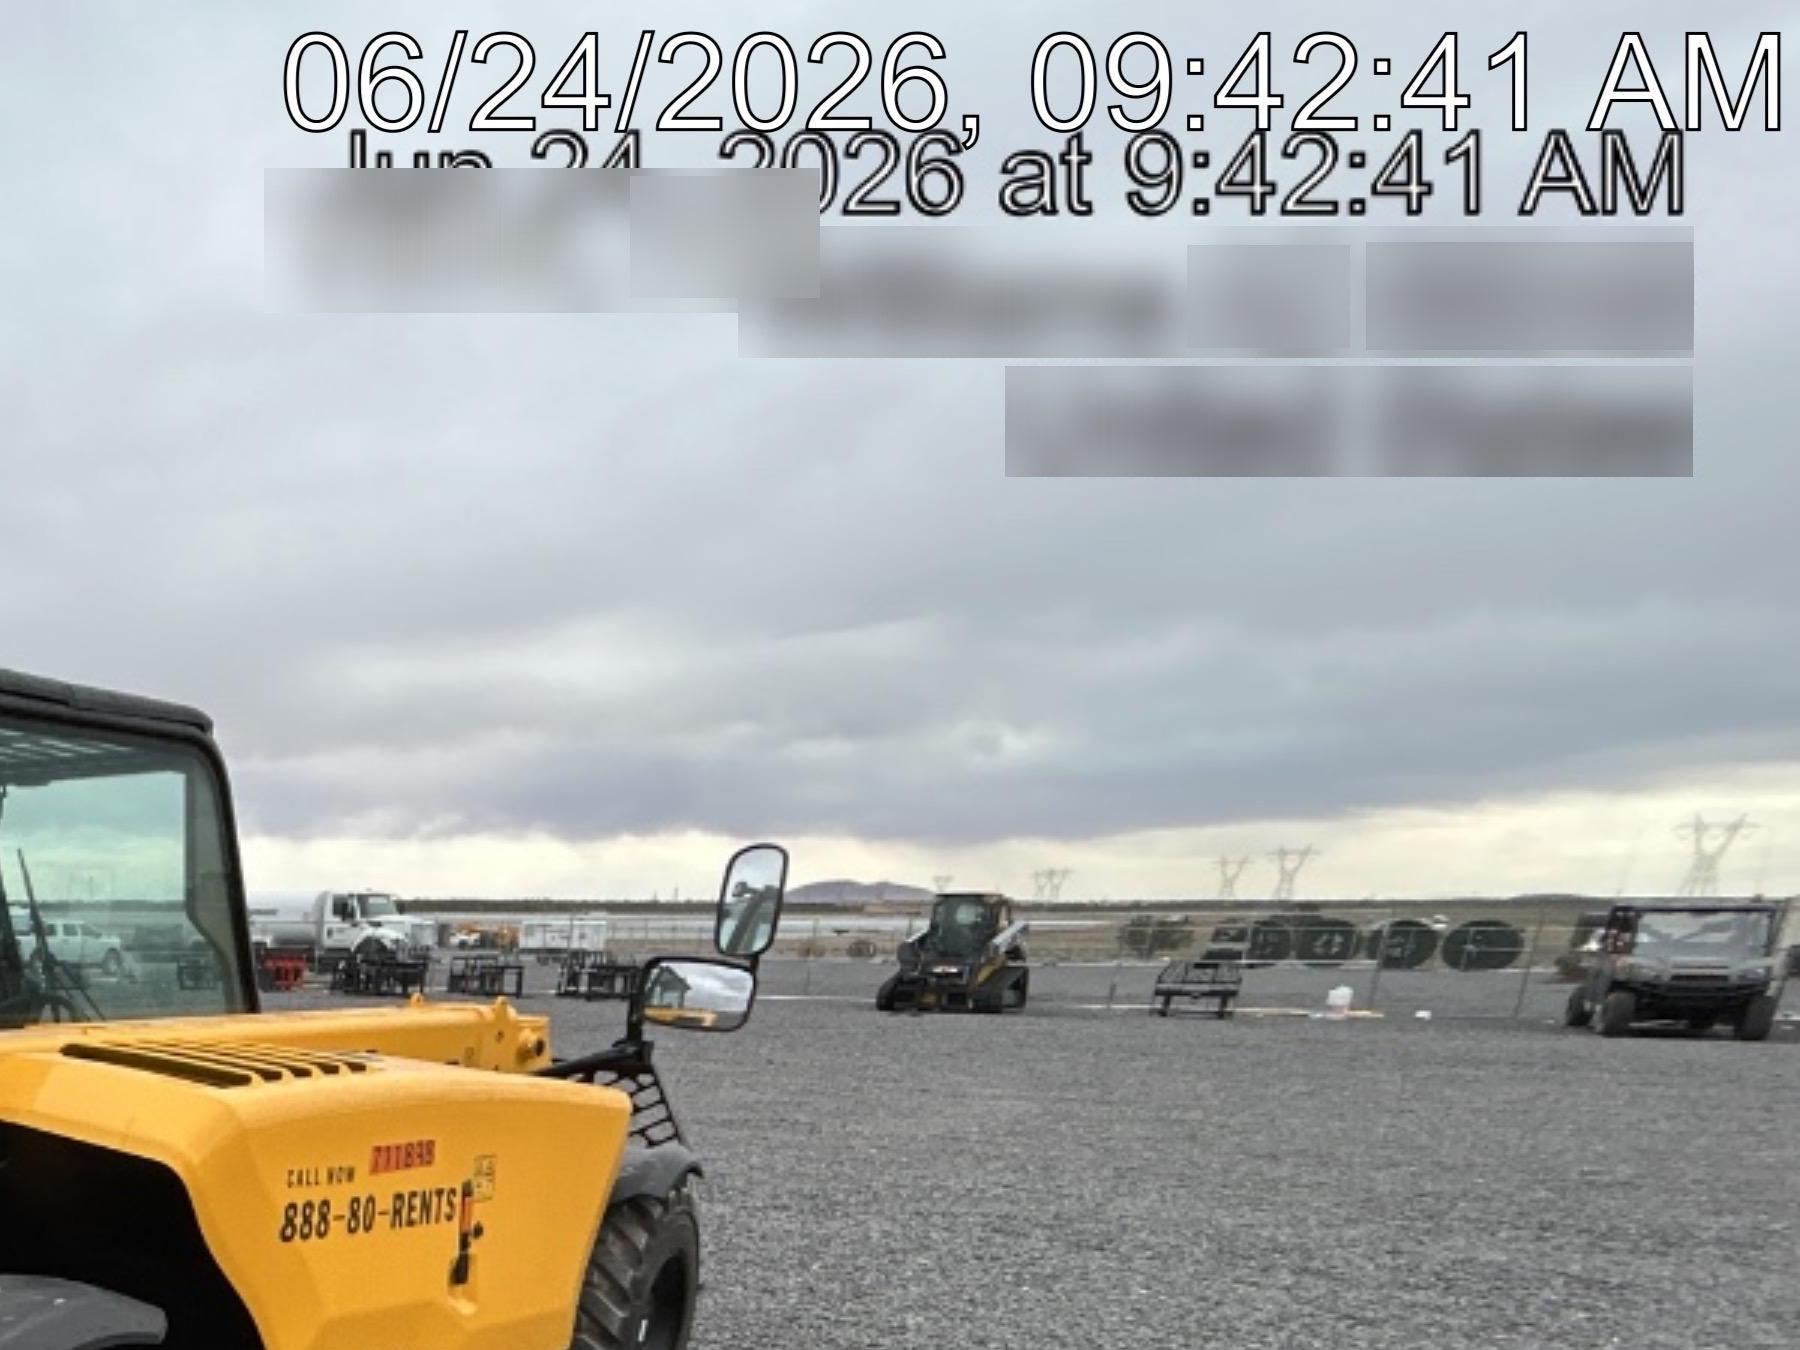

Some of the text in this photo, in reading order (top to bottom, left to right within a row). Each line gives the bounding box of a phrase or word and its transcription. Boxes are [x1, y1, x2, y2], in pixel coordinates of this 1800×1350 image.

[287, 1166, 356, 1189] CALL NOW
[279, 1187, 458, 1243] 888-80-RENTS
